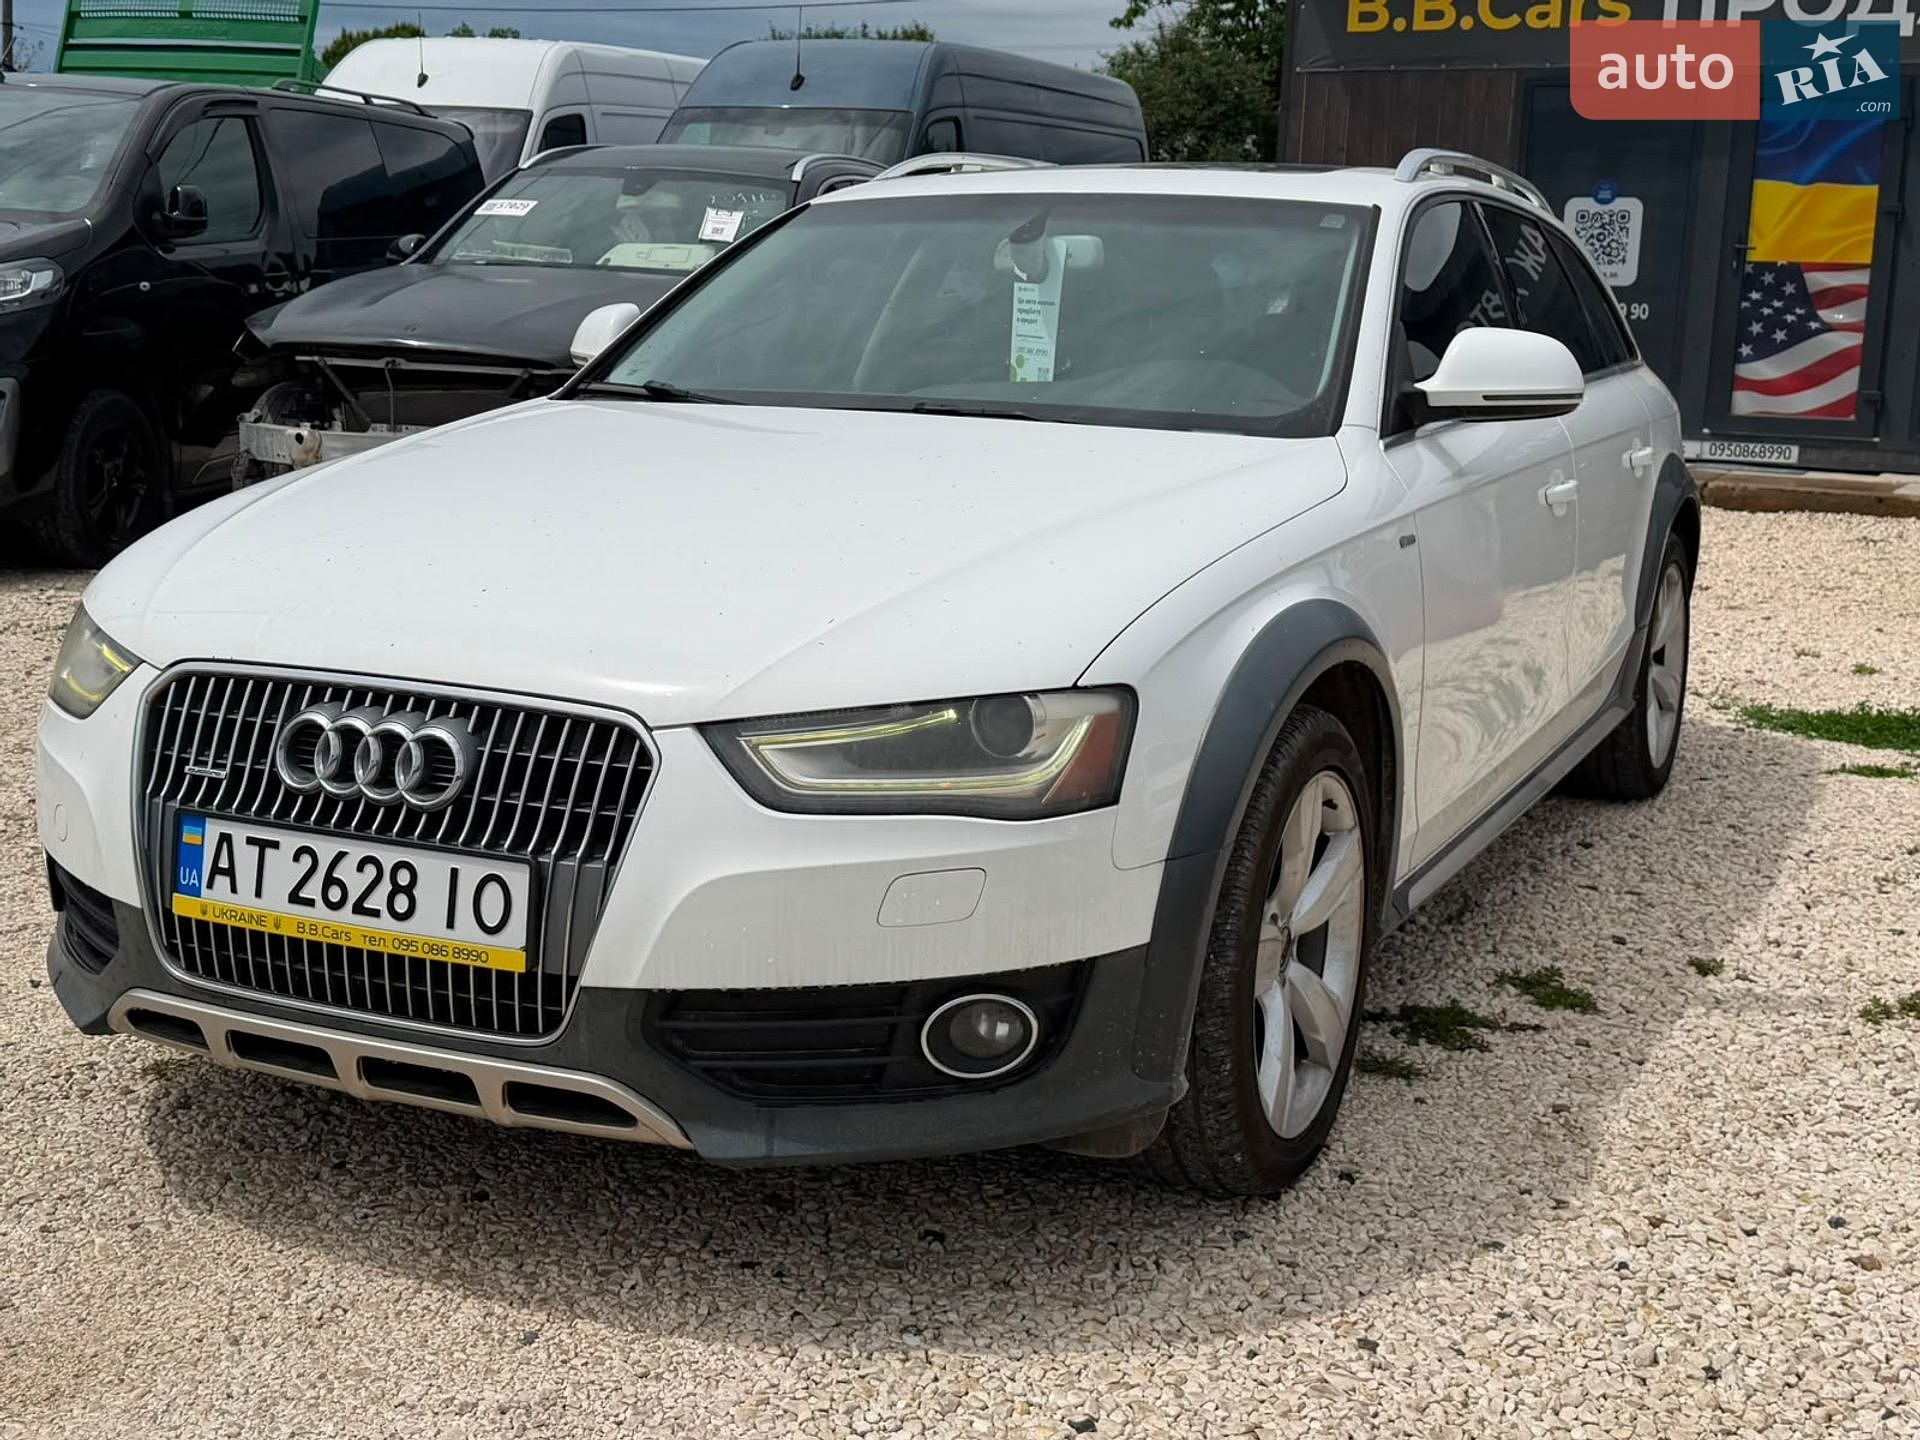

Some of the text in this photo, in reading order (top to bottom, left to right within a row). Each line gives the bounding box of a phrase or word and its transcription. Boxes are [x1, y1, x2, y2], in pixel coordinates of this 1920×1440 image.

[1347, 0, 1631, 32] B.B.Cars
[1662, 0, 1920, 36] ПРОД
[1630, 303, 1649, 320] 90
[1709, 442, 1792, 461] 0950868990
[179, 866, 199, 887] UA
[205, 831, 280, 899] AT
[288, 845, 418, 922] 2628
[212, 907, 268, 928] UKRAINE
[296, 921, 352, 942] B.B.Cars
[392, 937, 419, 953] 095
[421, 942, 449, 957] 086
[452, 946, 489, 964] 8990
